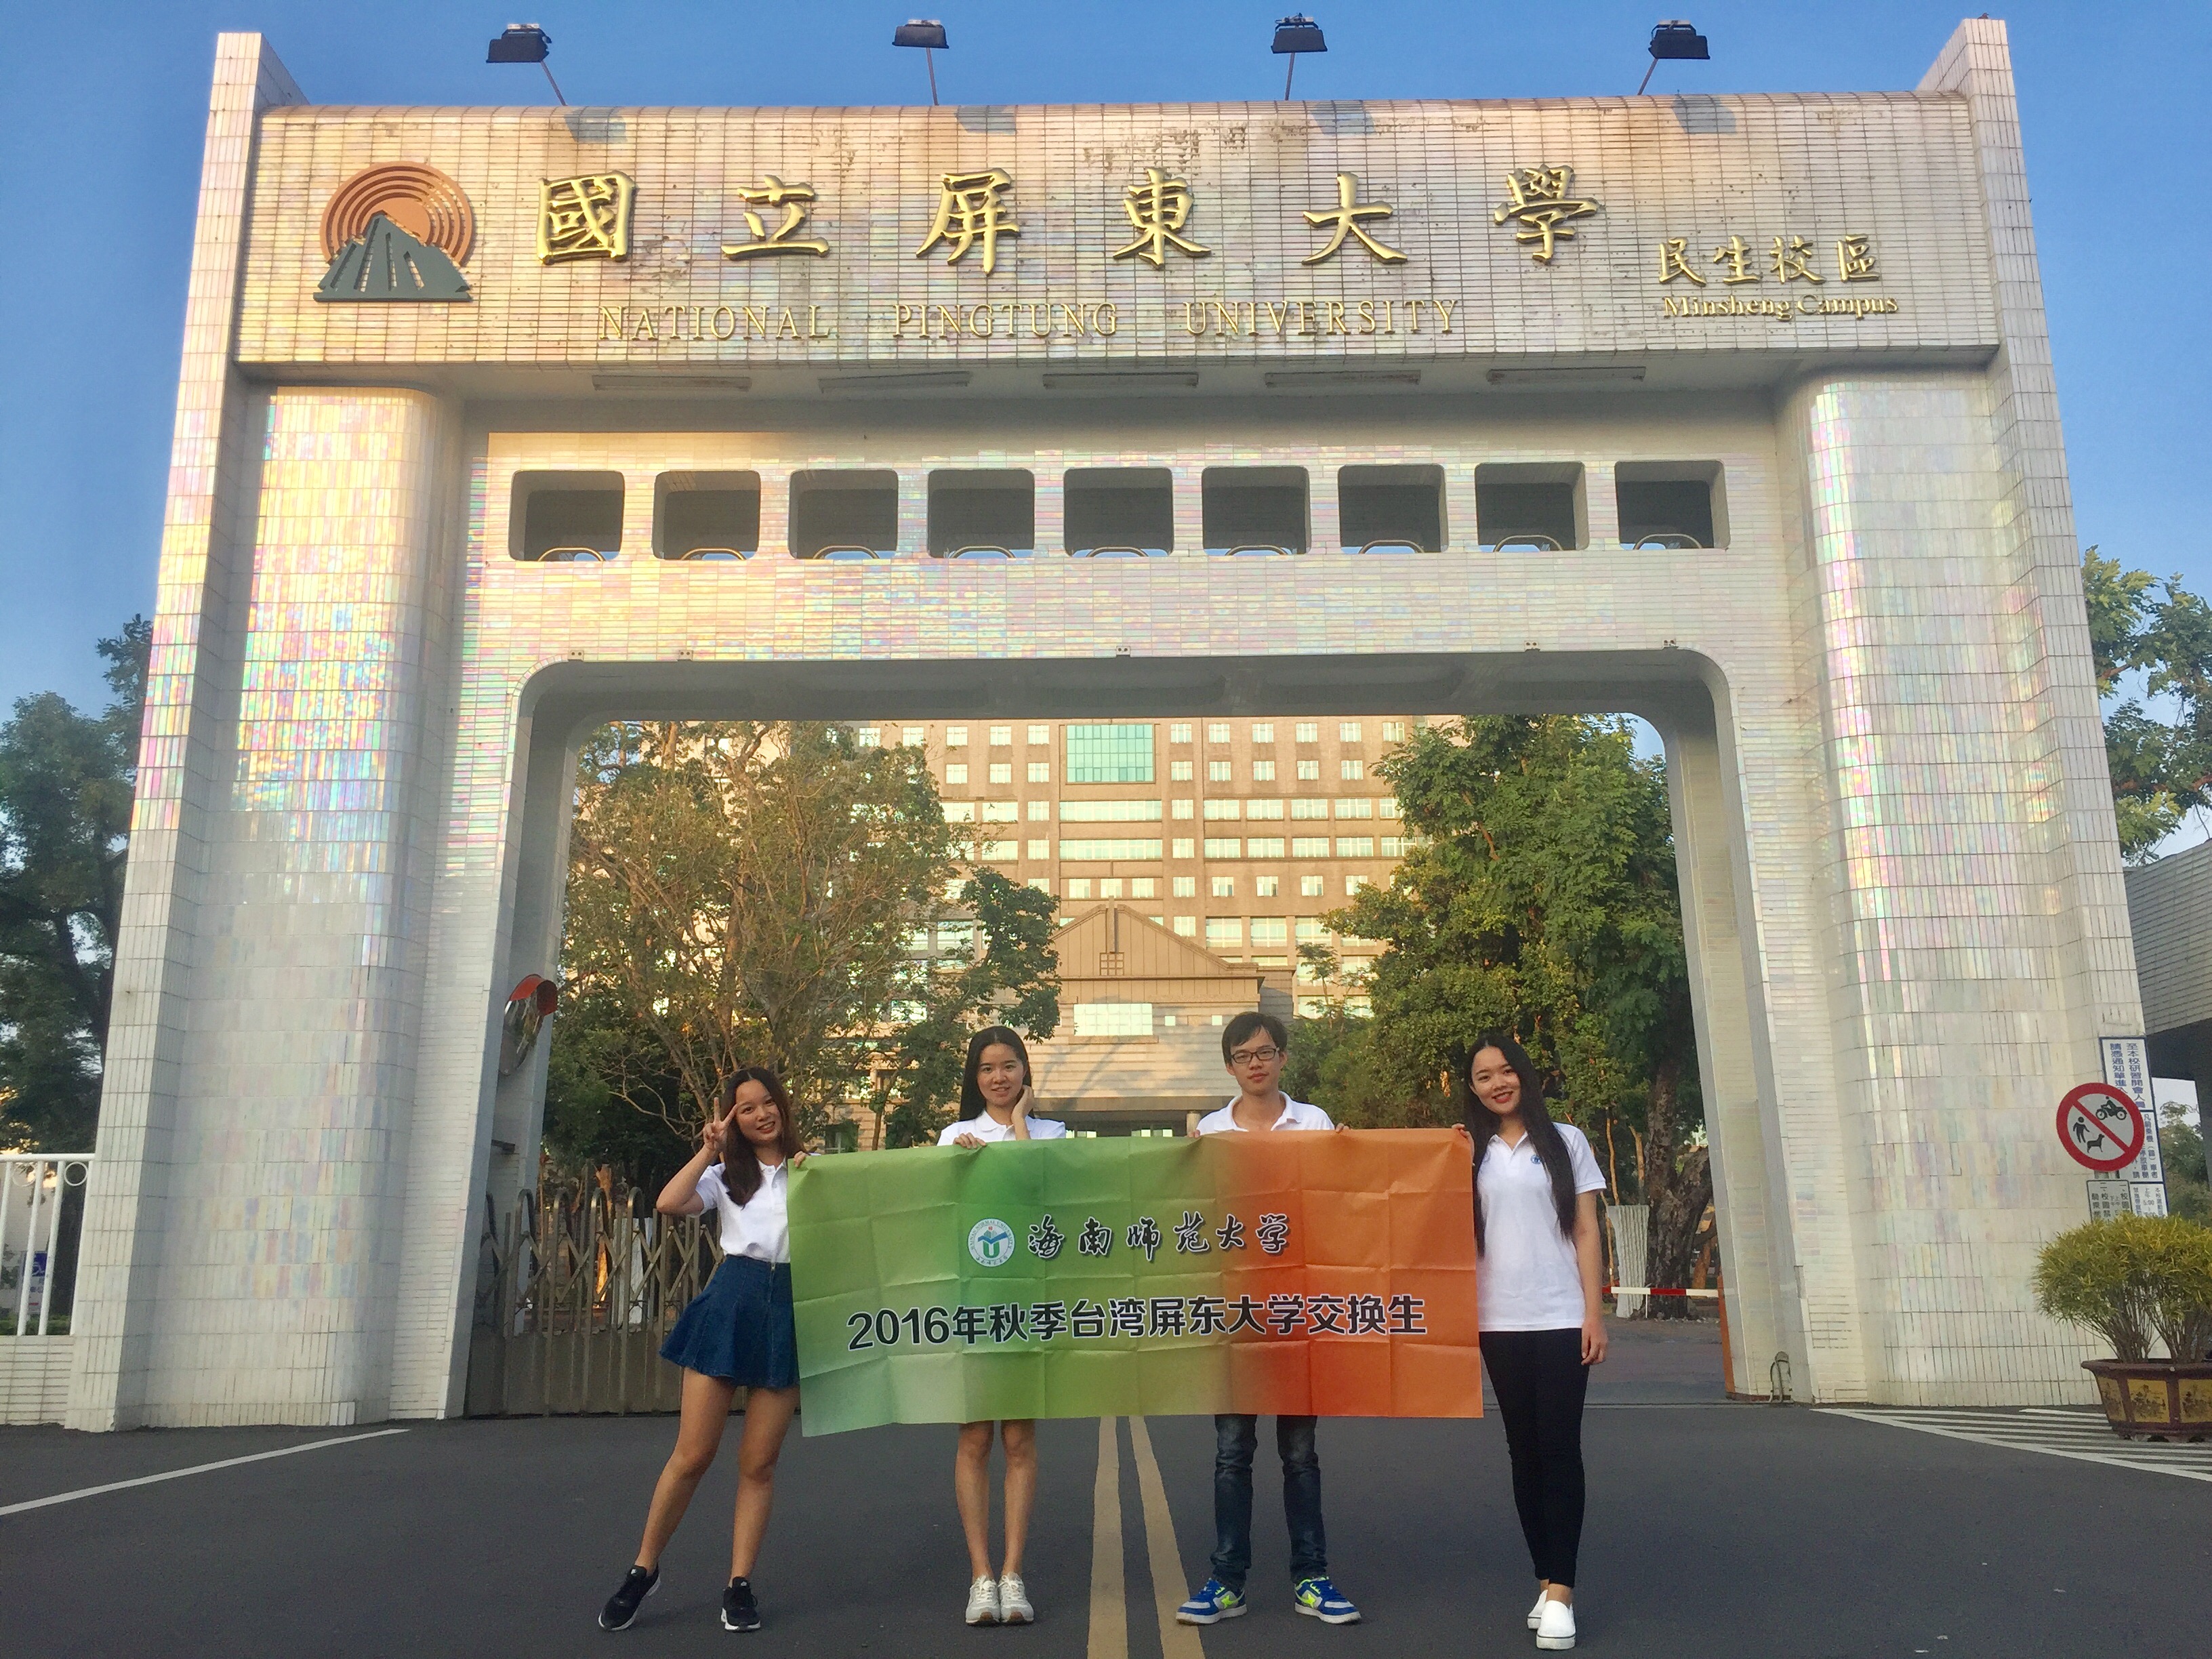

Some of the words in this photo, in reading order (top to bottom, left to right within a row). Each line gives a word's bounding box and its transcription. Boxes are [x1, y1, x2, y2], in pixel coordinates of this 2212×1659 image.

[537, 165, 1601, 275] 國立屏東大學
[1659, 234, 1881, 287] 民生校區
[599, 305, 834, 341] NATIONAL
[893, 302, 1118, 339] PINGTUNG
[1183, 300, 1458, 336] UNIVERSITY
[1663, 295, 1793, 321] Minsheng
[1797, 293, 1899, 320] Campus
[1028, 1211, 1290, 1262] 海南师范大学
[847, 1294, 1427, 1352] 2016年秋季台湾屏东大学交换生
